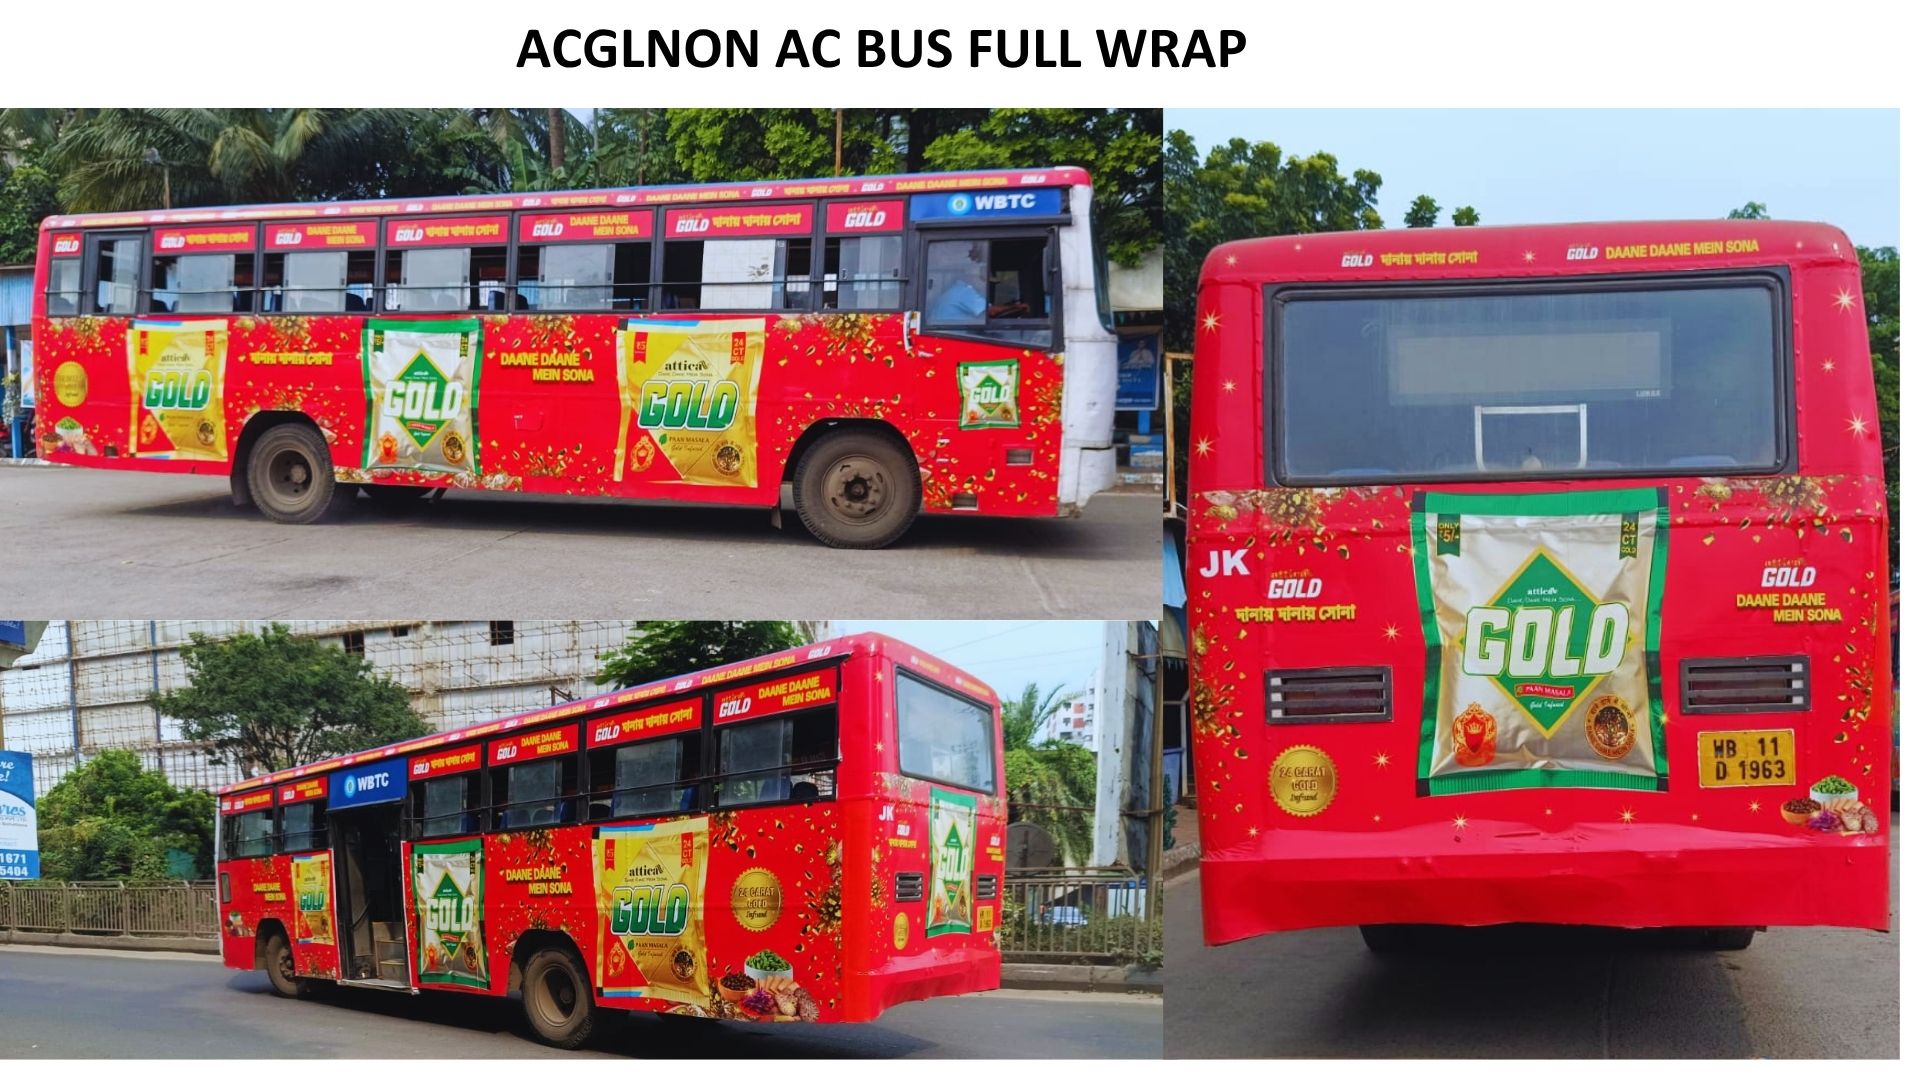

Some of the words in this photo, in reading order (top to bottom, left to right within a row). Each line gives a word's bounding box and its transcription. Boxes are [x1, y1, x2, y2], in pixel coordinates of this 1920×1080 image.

[974, 194, 1036, 211] WBTC
[570, 216, 598, 227] DAANE
[600, 215, 628, 225] DAANE
[676, 219, 709, 233] GOLD
[845, 211, 886, 227] GOLD
[395, 229, 423, 242] GOLD
[532, 223, 563, 237] GOLD
[593, 226, 616, 236] MEIN
[616, 225, 639, 235] SONA
[275, 232, 302, 245] GOLD
[1566, 247, 1598, 261] GOLD
[1606, 245, 1648, 260] DAANE
[1650, 243, 1692, 258] DAANE
[1694, 241, 1724, 256] MEIN
[1726, 239, 1759, 254] SONA
[1342, 254, 1373, 267] GOLD
[734, 338, 744, 347] 24
[501, 351, 539, 366] DAANE
[540, 351, 580, 366] DAANE
[733, 347, 744, 356] CT
[665, 360, 703, 371] attica
[533, 368, 561, 381] MEIN
[562, 368, 594, 382] SONA
[144, 370, 212, 410] GOLD
[970, 386, 1010, 403] GOLD
[383, 380, 463, 421] GOLD
[638, 380, 740, 431] GOLD
[1623, 522, 1636, 532] 24
[1622, 535, 1637, 546] CT
[1200, 549, 1250, 577] JK
[1761, 566, 1816, 588] GOLD
[1267, 578, 1322, 600] GOLD
[1736, 594, 1779, 607] DAANE
[1782, 593, 1826, 606] DAANE
[1235, 606, 1275, 622] দানায়
[1277, 605, 1317, 622] দানায়
[1319, 604, 1356, 620] সোনা
[1773, 610, 1804, 622] MEIN
[1807, 608, 1842, 621] SONA
[1462, 601, 1630, 678] GOLD
[702, 672, 726, 685] DAANE
[726, 667, 751, 680] DAANE
[752, 661, 773, 674] MEIN
[774, 655, 796, 668] SONA
[758, 683, 787, 699] DAANE
[788, 677, 820, 693] DAANE
[1525, 686, 1544, 694] PAAN
[782, 693, 804, 707] MEIN
[805, 688, 831, 703] SONA
[719, 698, 751, 718] GOLD
[521, 736, 541, 747] DAANE
[542, 731, 562, 743] DAANE
[595, 725, 620, 742] GOLD
[497, 746, 517, 760] GOLD
[537, 743, 552, 754] MEIN
[553, 741, 569, 752] SONA
[1713, 739, 1737, 759] WB
[1758, 737, 1779, 756] 11
[413, 762, 430, 775] GOLD
[1295, 767, 1326, 777] CARAT
[1715, 762, 1727, 781] D
[1738, 760, 1786, 780] 1963
[357, 773, 389, 792] WBTC
[1292, 781, 1318, 790] GOLD
[879, 805, 894, 822] JK
[683, 839, 692, 849] 24
[683, 850, 692, 858] CT
[506, 868, 533, 881] DAANE
[534, 866, 561, 880] DAANE
[629, 865, 657, 877] attica
[529, 883, 548, 894] MEIN
[549, 882, 572, 894] SONA
[750, 887, 775, 897] CARAT
[426, 897, 474, 931] GOLD
[611, 883, 690, 936] GOLD
